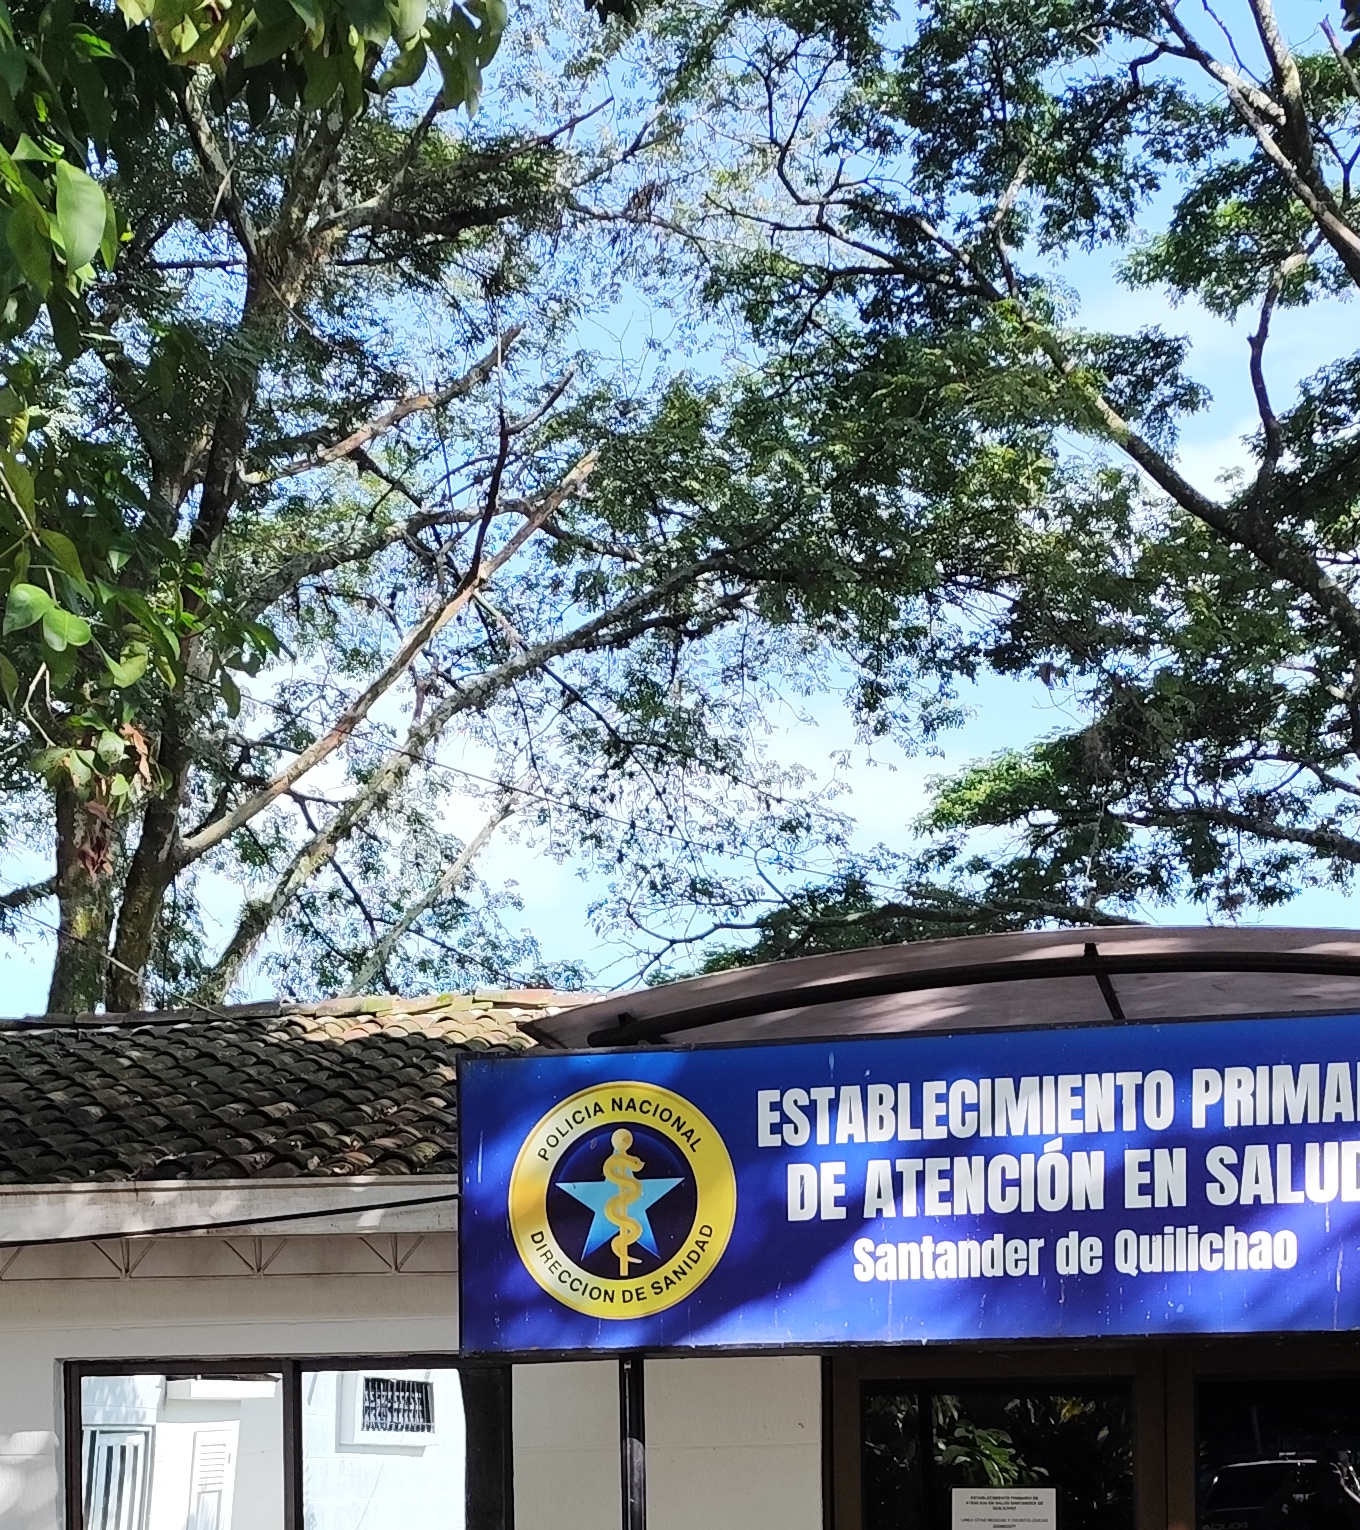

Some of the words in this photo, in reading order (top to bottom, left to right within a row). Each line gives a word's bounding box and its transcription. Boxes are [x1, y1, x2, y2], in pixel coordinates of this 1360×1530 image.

[537, 1101, 606, 1161] POLICIA
[611, 1097, 703, 1153] NACIONAL
[757, 1069, 1175, 1148] ESTABLECIMIENTO
[787, 1161, 847, 1222] DE
[863, 1136, 1105, 1219] ATENCIÓN
[1124, 1148, 1187, 1209] EN
[530, 1230, 615, 1304] DIRECCION
[621, 1286, 647, 1304] DE
[650, 1224, 713, 1296] SANIDAD
[853, 1233, 1045, 1283] Santander
[1056, 1231, 1103, 1276] de
[1114, 1225, 1298, 1278] Quilichao
